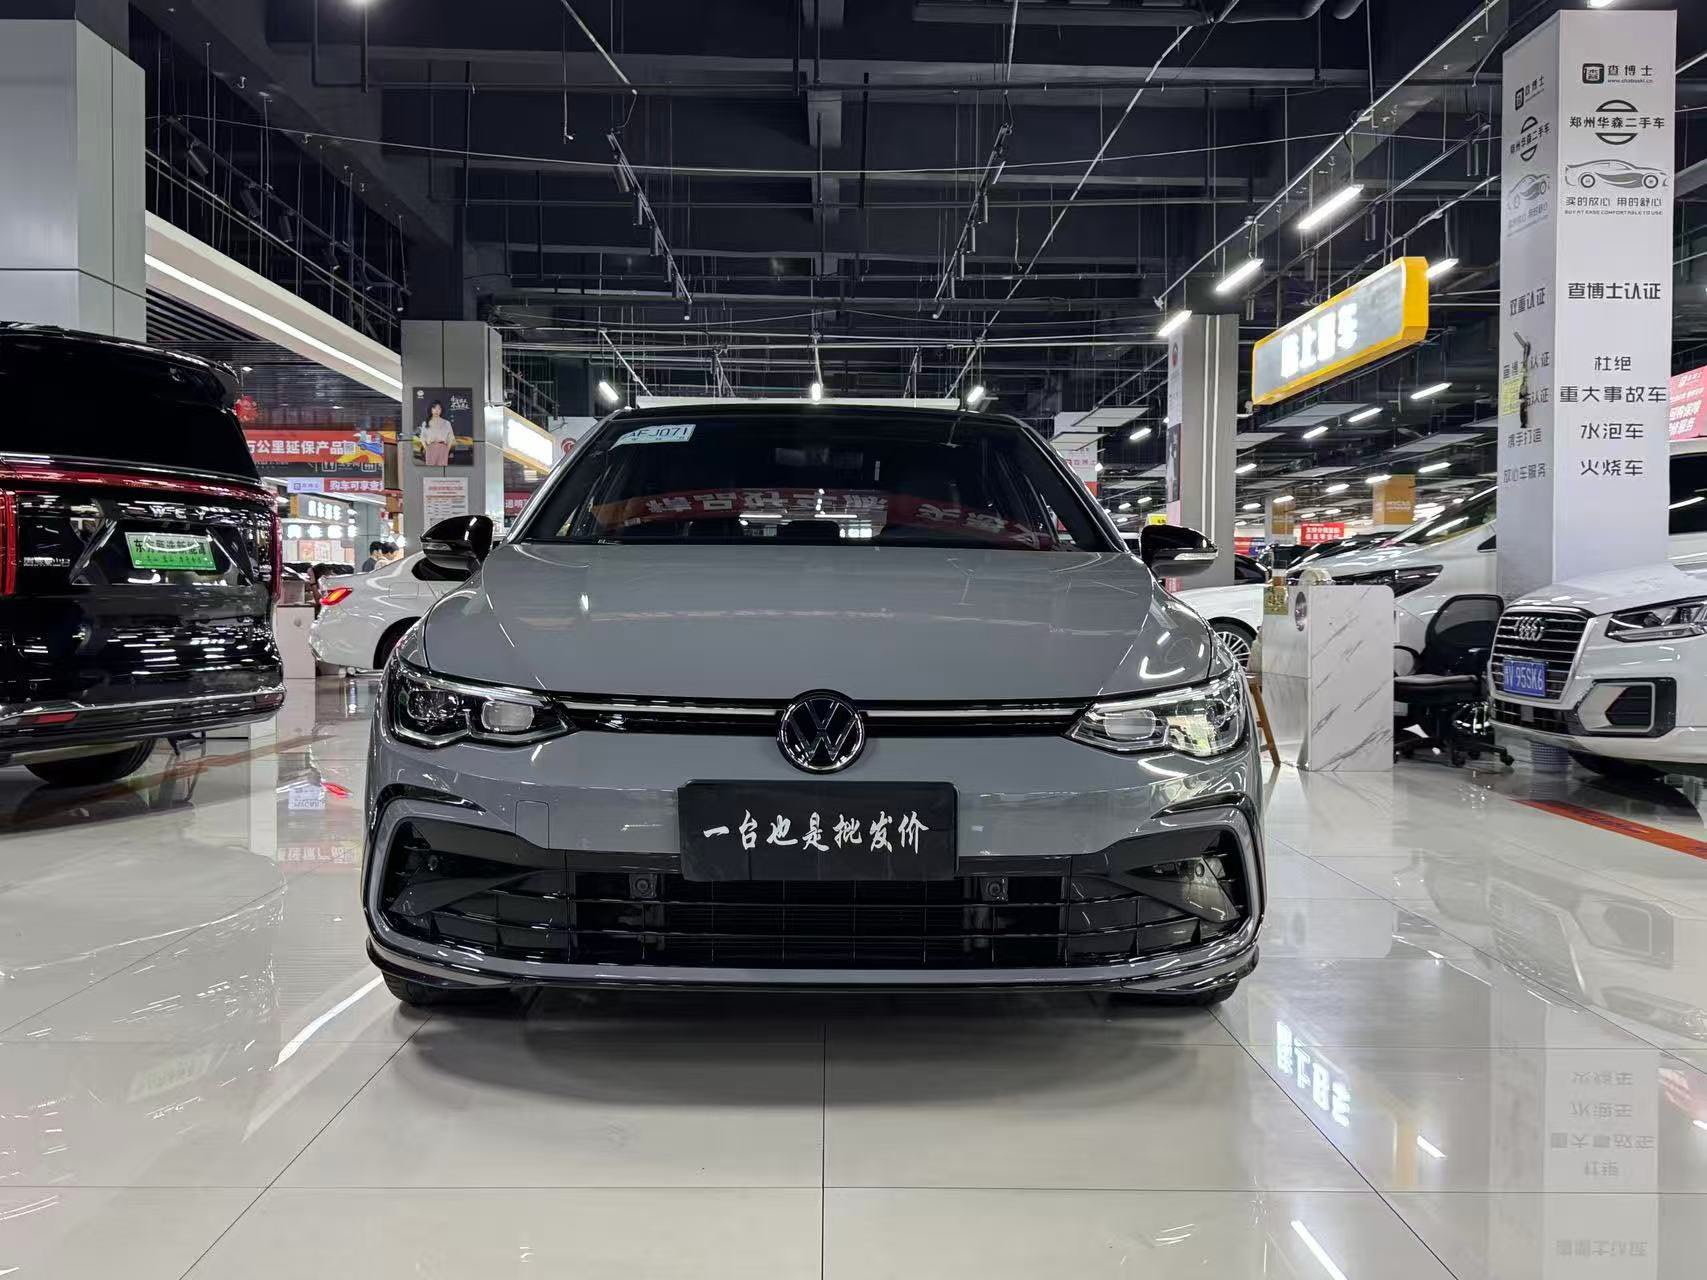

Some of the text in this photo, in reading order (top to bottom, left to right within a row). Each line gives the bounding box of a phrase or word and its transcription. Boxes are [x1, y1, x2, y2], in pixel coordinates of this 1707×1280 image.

[1607, 65, 1653, 77] 查博士
[1569, 116, 1665, 129] 郑州华森二手车
[1566, 197, 1662, 206] 买的放心 用的舒心
[1568, 283, 1660, 299] 查博士认证
[1510, 287, 1546, 316] 双重认证
[1594, 356, 1631, 371] 杜绝
[1560, 386, 1667, 402] 重大事故车
[1581, 423, 1643, 439] 水泡车
[1580, 459, 1643, 476] 火烧车
[703, 809, 929, 853] 一台也是批发价
